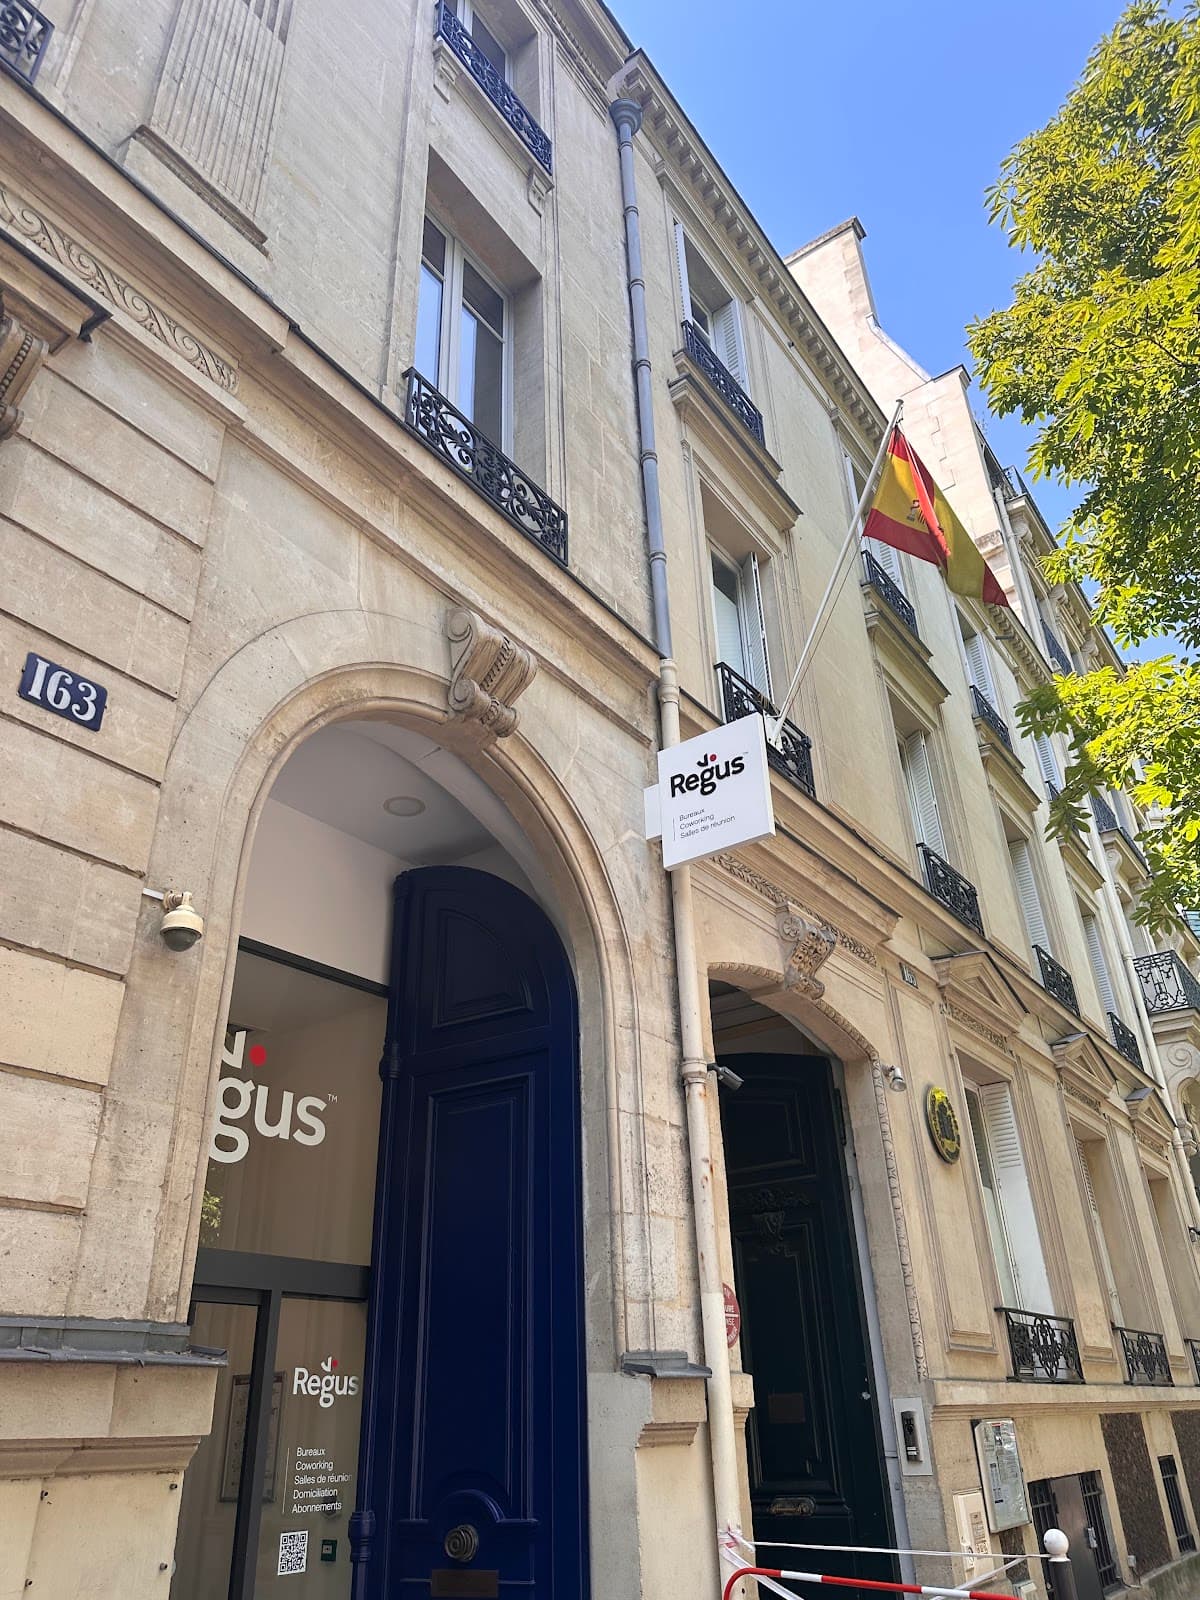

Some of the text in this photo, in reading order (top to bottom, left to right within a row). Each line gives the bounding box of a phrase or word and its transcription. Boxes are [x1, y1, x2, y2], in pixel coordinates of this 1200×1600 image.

[28, 658, 97, 721] 163
[670, 756, 745, 798] Regus
[680, 808, 705, 822] Bureaux
[680, 814, 715, 830] Coworking
[680, 827, 700, 839] Salles
[700, 824, 709, 832] de
[293, 1366, 359, 1408] Regus
[296, 1447, 326, 1457] Bureaux
[295, 1460, 334, 1471] Coworking
[294, 1475, 316, 1485] Salles
[316, 1474, 327, 1483] de
[293, 1488, 338, 1499] Domiciliation
[292, 1502, 342, 1513] Abonnements
